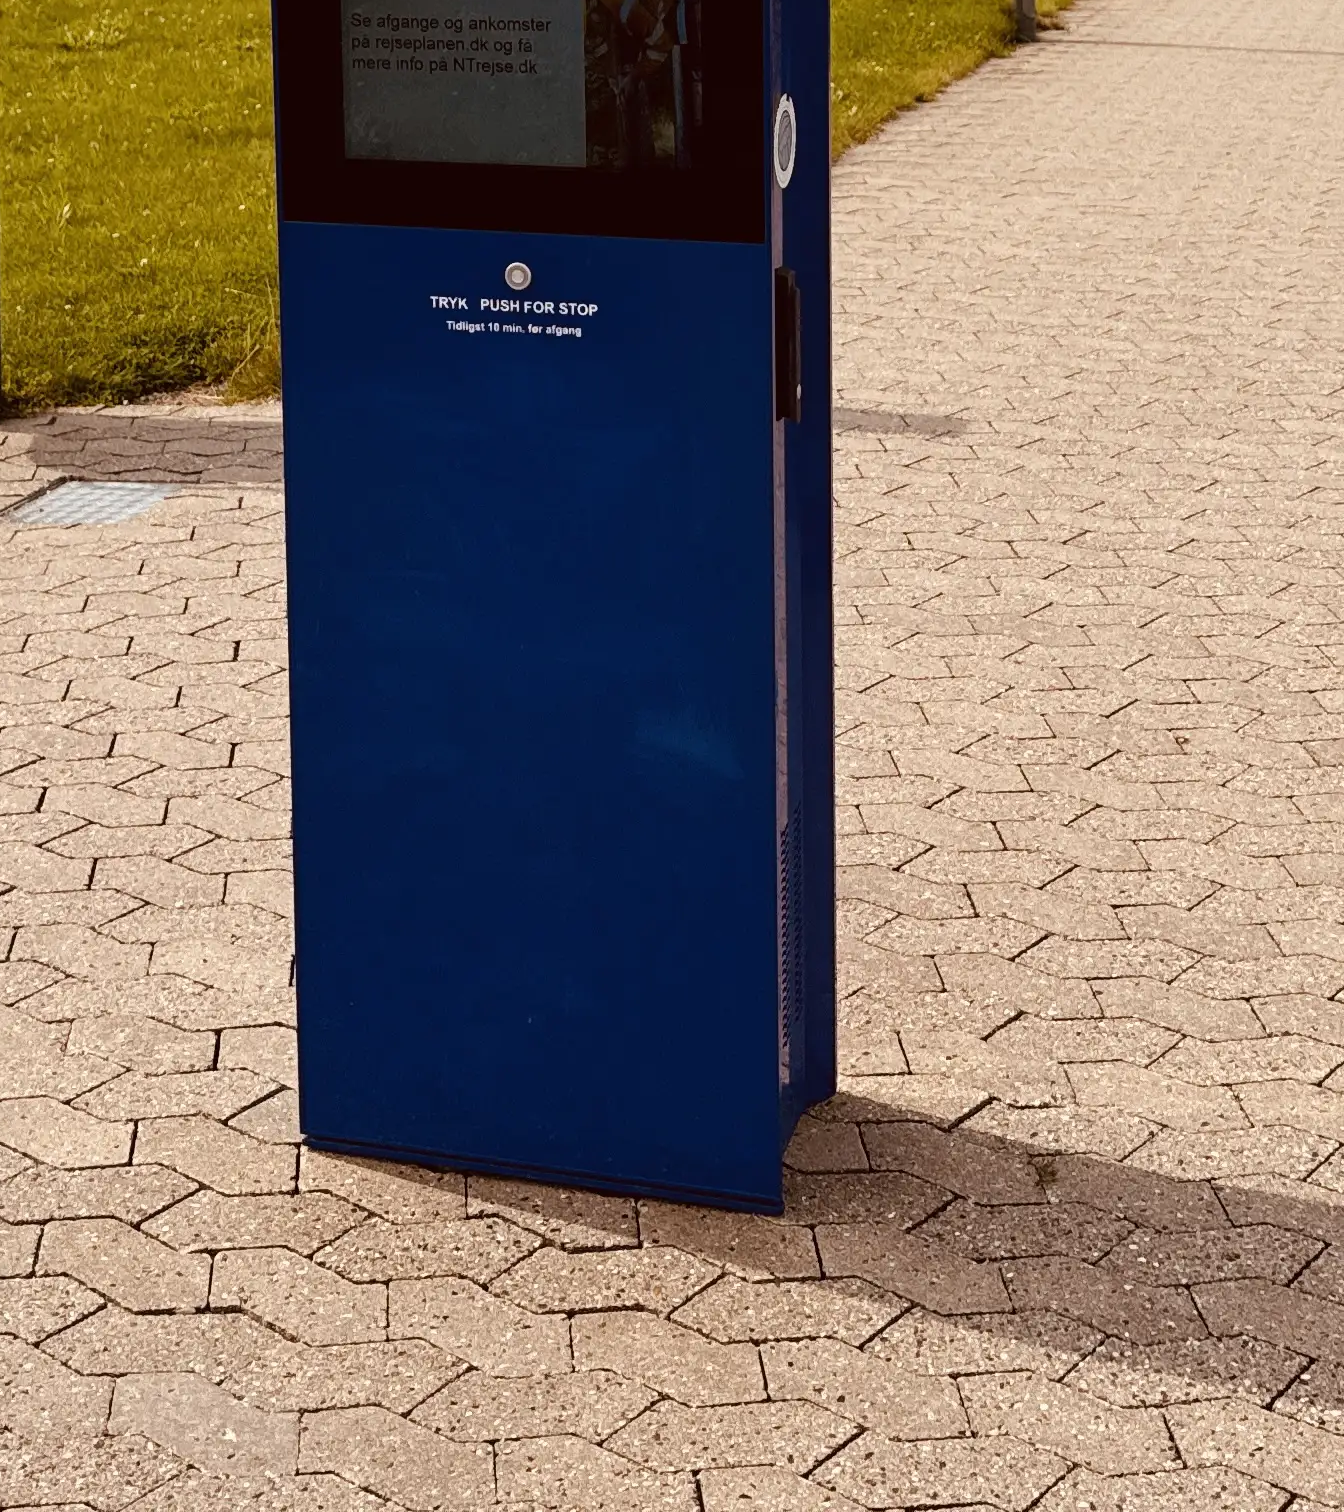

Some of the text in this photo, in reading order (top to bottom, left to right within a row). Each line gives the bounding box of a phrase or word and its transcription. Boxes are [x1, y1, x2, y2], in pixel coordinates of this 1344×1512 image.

[351, 14, 551, 32] Se afgange og ankomster
[352, 36, 532, 55] på rejseplanen.dk og få
[352, 57, 538, 76] mere info på NTrejse.dk
[430, 296, 598, 316] TRYK PUSH FOR STOP
[446, 321, 582, 337] Tidligst 10 min. før afgang
